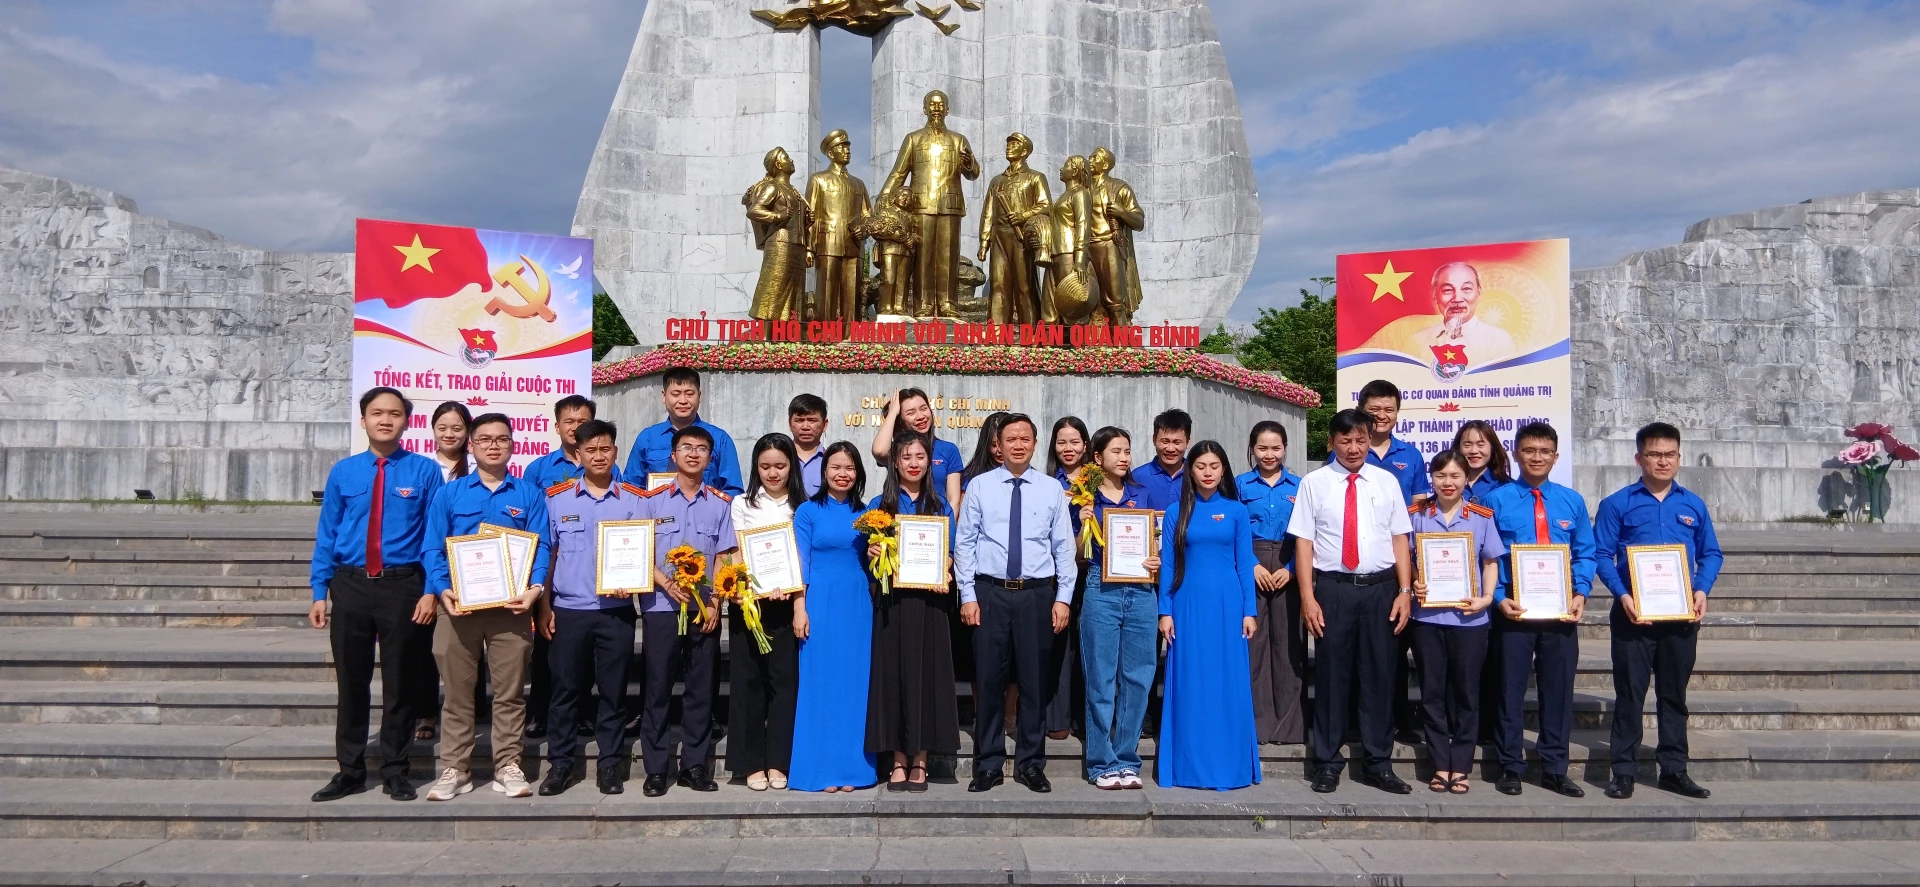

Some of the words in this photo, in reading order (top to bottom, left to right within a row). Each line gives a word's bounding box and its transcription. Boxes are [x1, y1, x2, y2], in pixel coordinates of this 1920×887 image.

[666, 311, 709, 341] CHỦ
[717, 319, 764, 346] TỊCH
[772, 310, 800, 342] HỒ
[807, 317, 843, 343] CHÍ
[850, 321, 906, 343] MINH
[914, 318, 947, 344] VỚI
[954, 318, 1014, 345] NHÂN
[1020, 320, 1063, 346] DÂN
[1070, 317, 1142, 348] QUẢNG
[374, 365, 411, 387] TỔNG
[416, 368, 443, 391] KẾT,
[447, 374, 481, 390] TRAO
[485, 371, 512, 391] GIẢI
[516, 375, 551, 396] CUỘC
[555, 379, 575, 394] THI
[1411, 389, 1423, 399] CƠ
[1426, 389, 1449, 400] QUAN
[1452, 386, 1477, 398] ĐẢNG
[1479, 385, 1500, 397] TỈNH
[1503, 384, 1534, 398] QUẢNG
[1537, 386, 1552, 397] TRỊ
[949, 395, 973, 411] CHÍ
[975, 398, 1011, 411] MINH
[844, 412, 866, 427] VỚI
[947, 413, 985, 429] QUẢN
[1395, 419, 1415, 435] LẬP
[1418, 418, 1453, 433] THÀNH
[512, 437, 549, 455] ĐẢNG
[1420, 441, 1438, 453] 136
